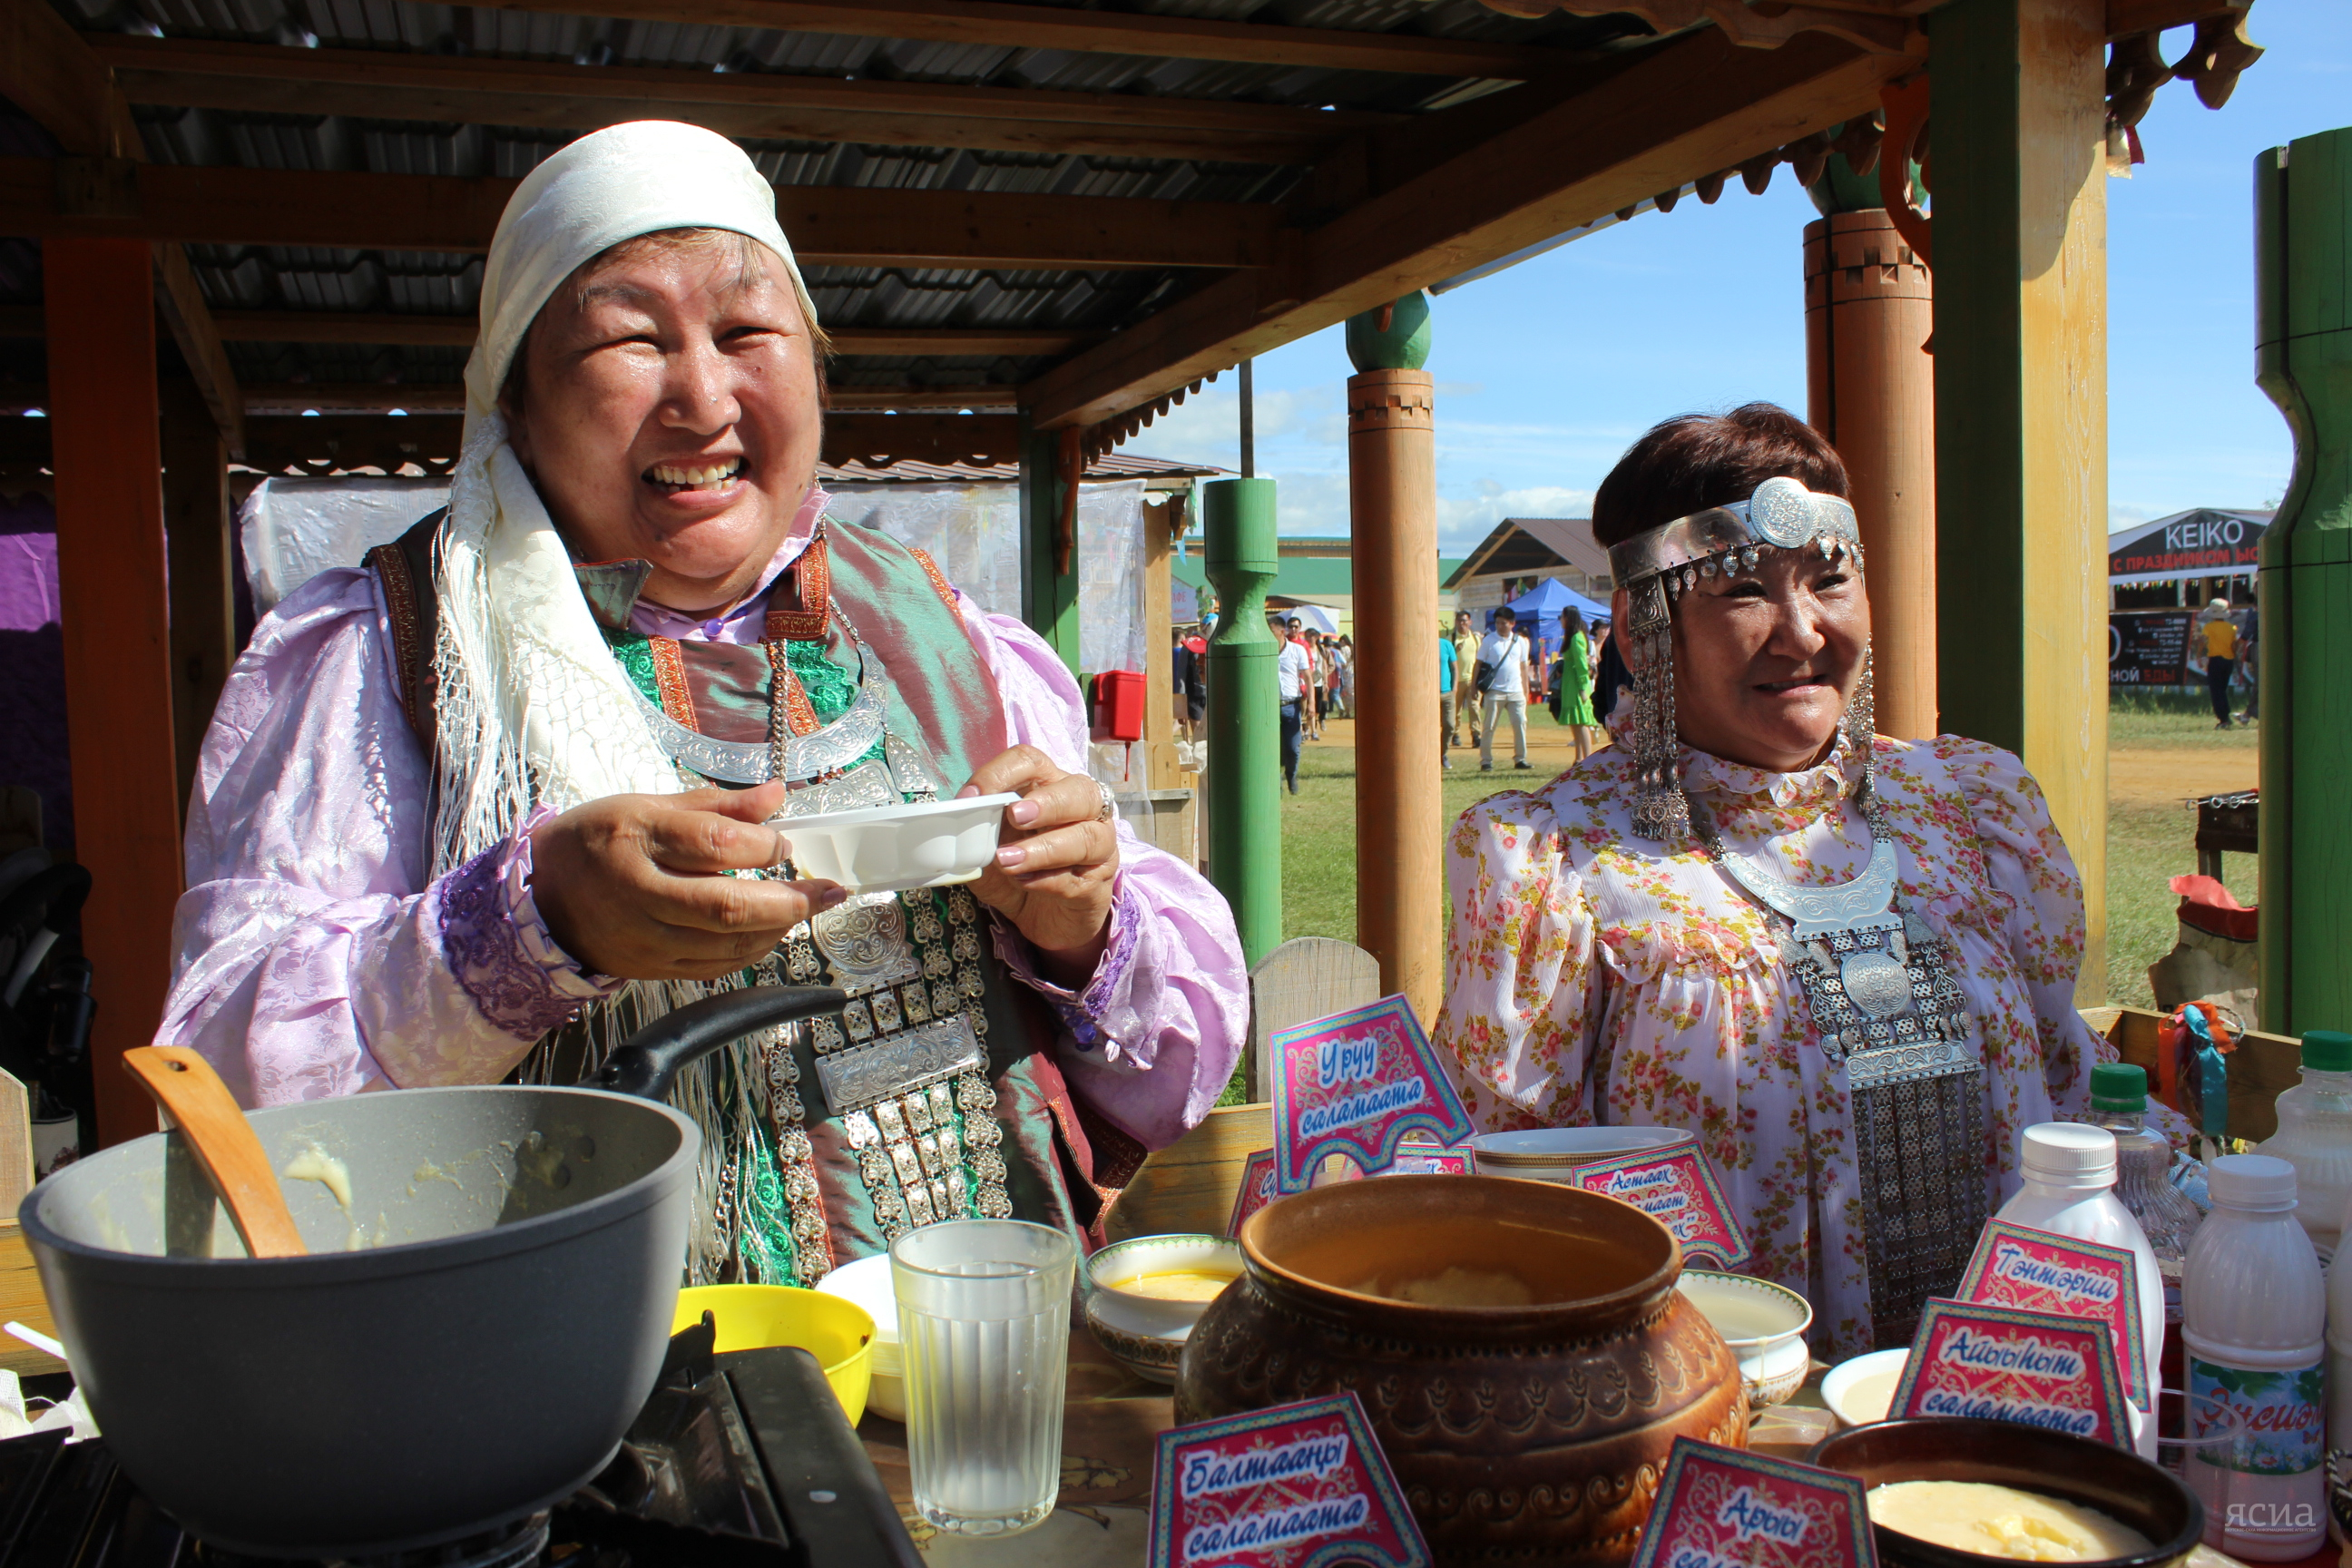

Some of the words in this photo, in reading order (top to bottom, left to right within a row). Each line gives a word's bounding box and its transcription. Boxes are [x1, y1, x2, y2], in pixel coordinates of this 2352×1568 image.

[2165, 519, 2244, 549] KEIKO
[2112, 558, 2122, 572] С
[2126, 549, 2230, 571] ПРАЗДНИКОМ
[2143, 669, 2177, 683] ЕДЫ
[1302, 1080, 1423, 1134] саламаата
[1611, 1168, 1676, 1192] Астаах
[1188, 1498, 1365, 1556] саламаата
